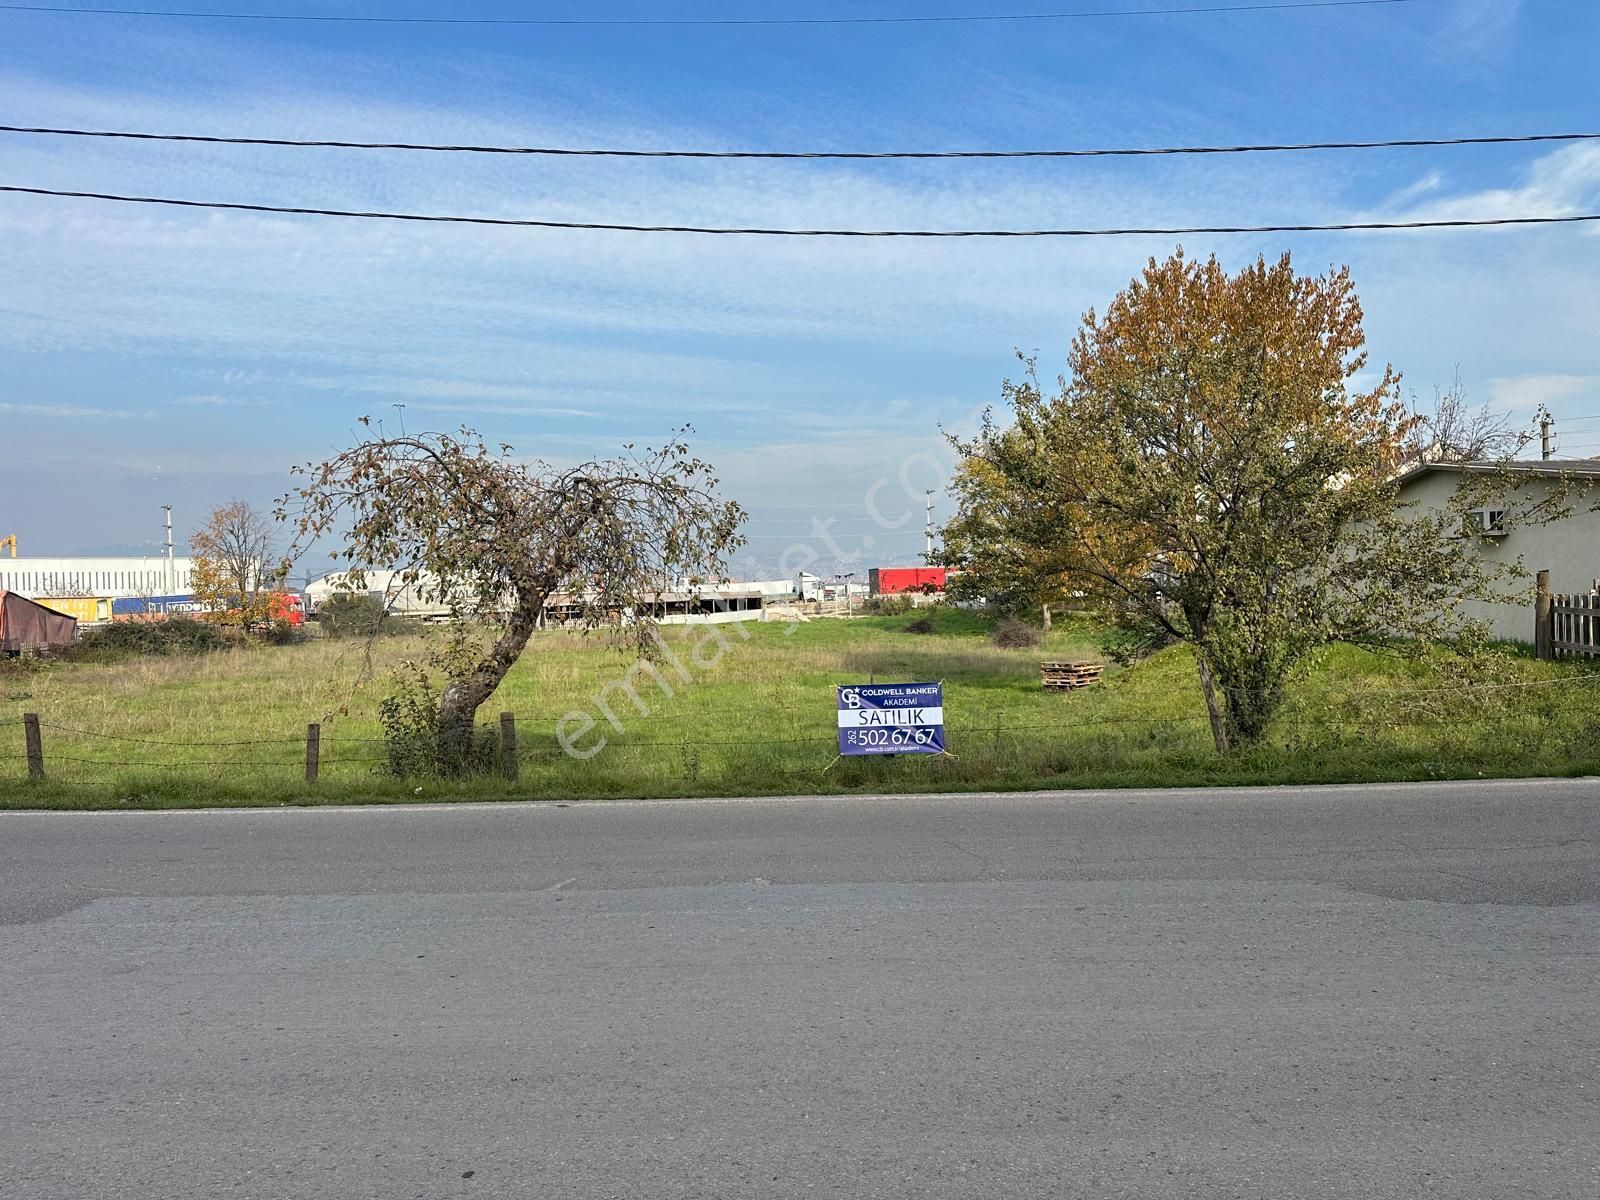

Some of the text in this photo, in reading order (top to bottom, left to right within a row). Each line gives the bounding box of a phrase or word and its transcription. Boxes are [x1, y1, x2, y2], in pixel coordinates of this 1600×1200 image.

[906, 687, 938, 695] BANKER
[883, 698, 918, 706] AKADEMİ
[859, 708, 924, 725] SATILIK
[848, 730, 857, 744] 262
[859, 728, 935, 745] 502 67 67
